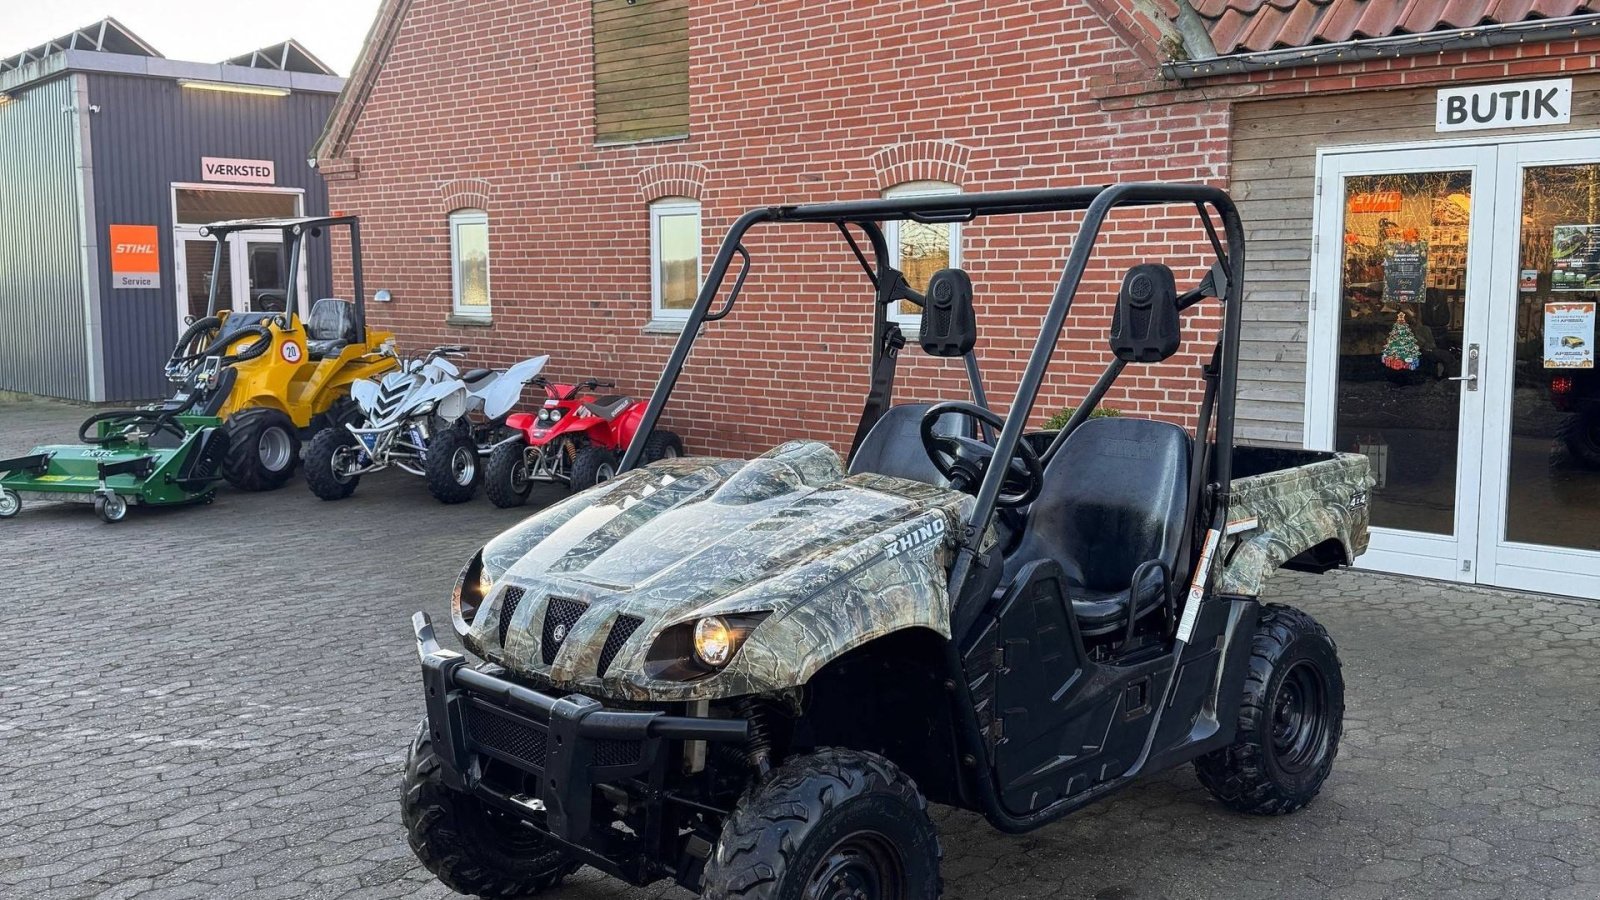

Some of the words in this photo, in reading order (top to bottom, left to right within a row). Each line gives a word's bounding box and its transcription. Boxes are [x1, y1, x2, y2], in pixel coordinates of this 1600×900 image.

[1446, 87, 1559, 124] BUTIK
[206, 163, 271, 178] VÆRKSTED
[1354, 193, 1397, 205] STIHL
[115, 243, 155, 254] STIHL
[122, 276, 152, 286] Service
[286, 346, 297, 358] 20
[883, 518, 945, 560] RHINO
